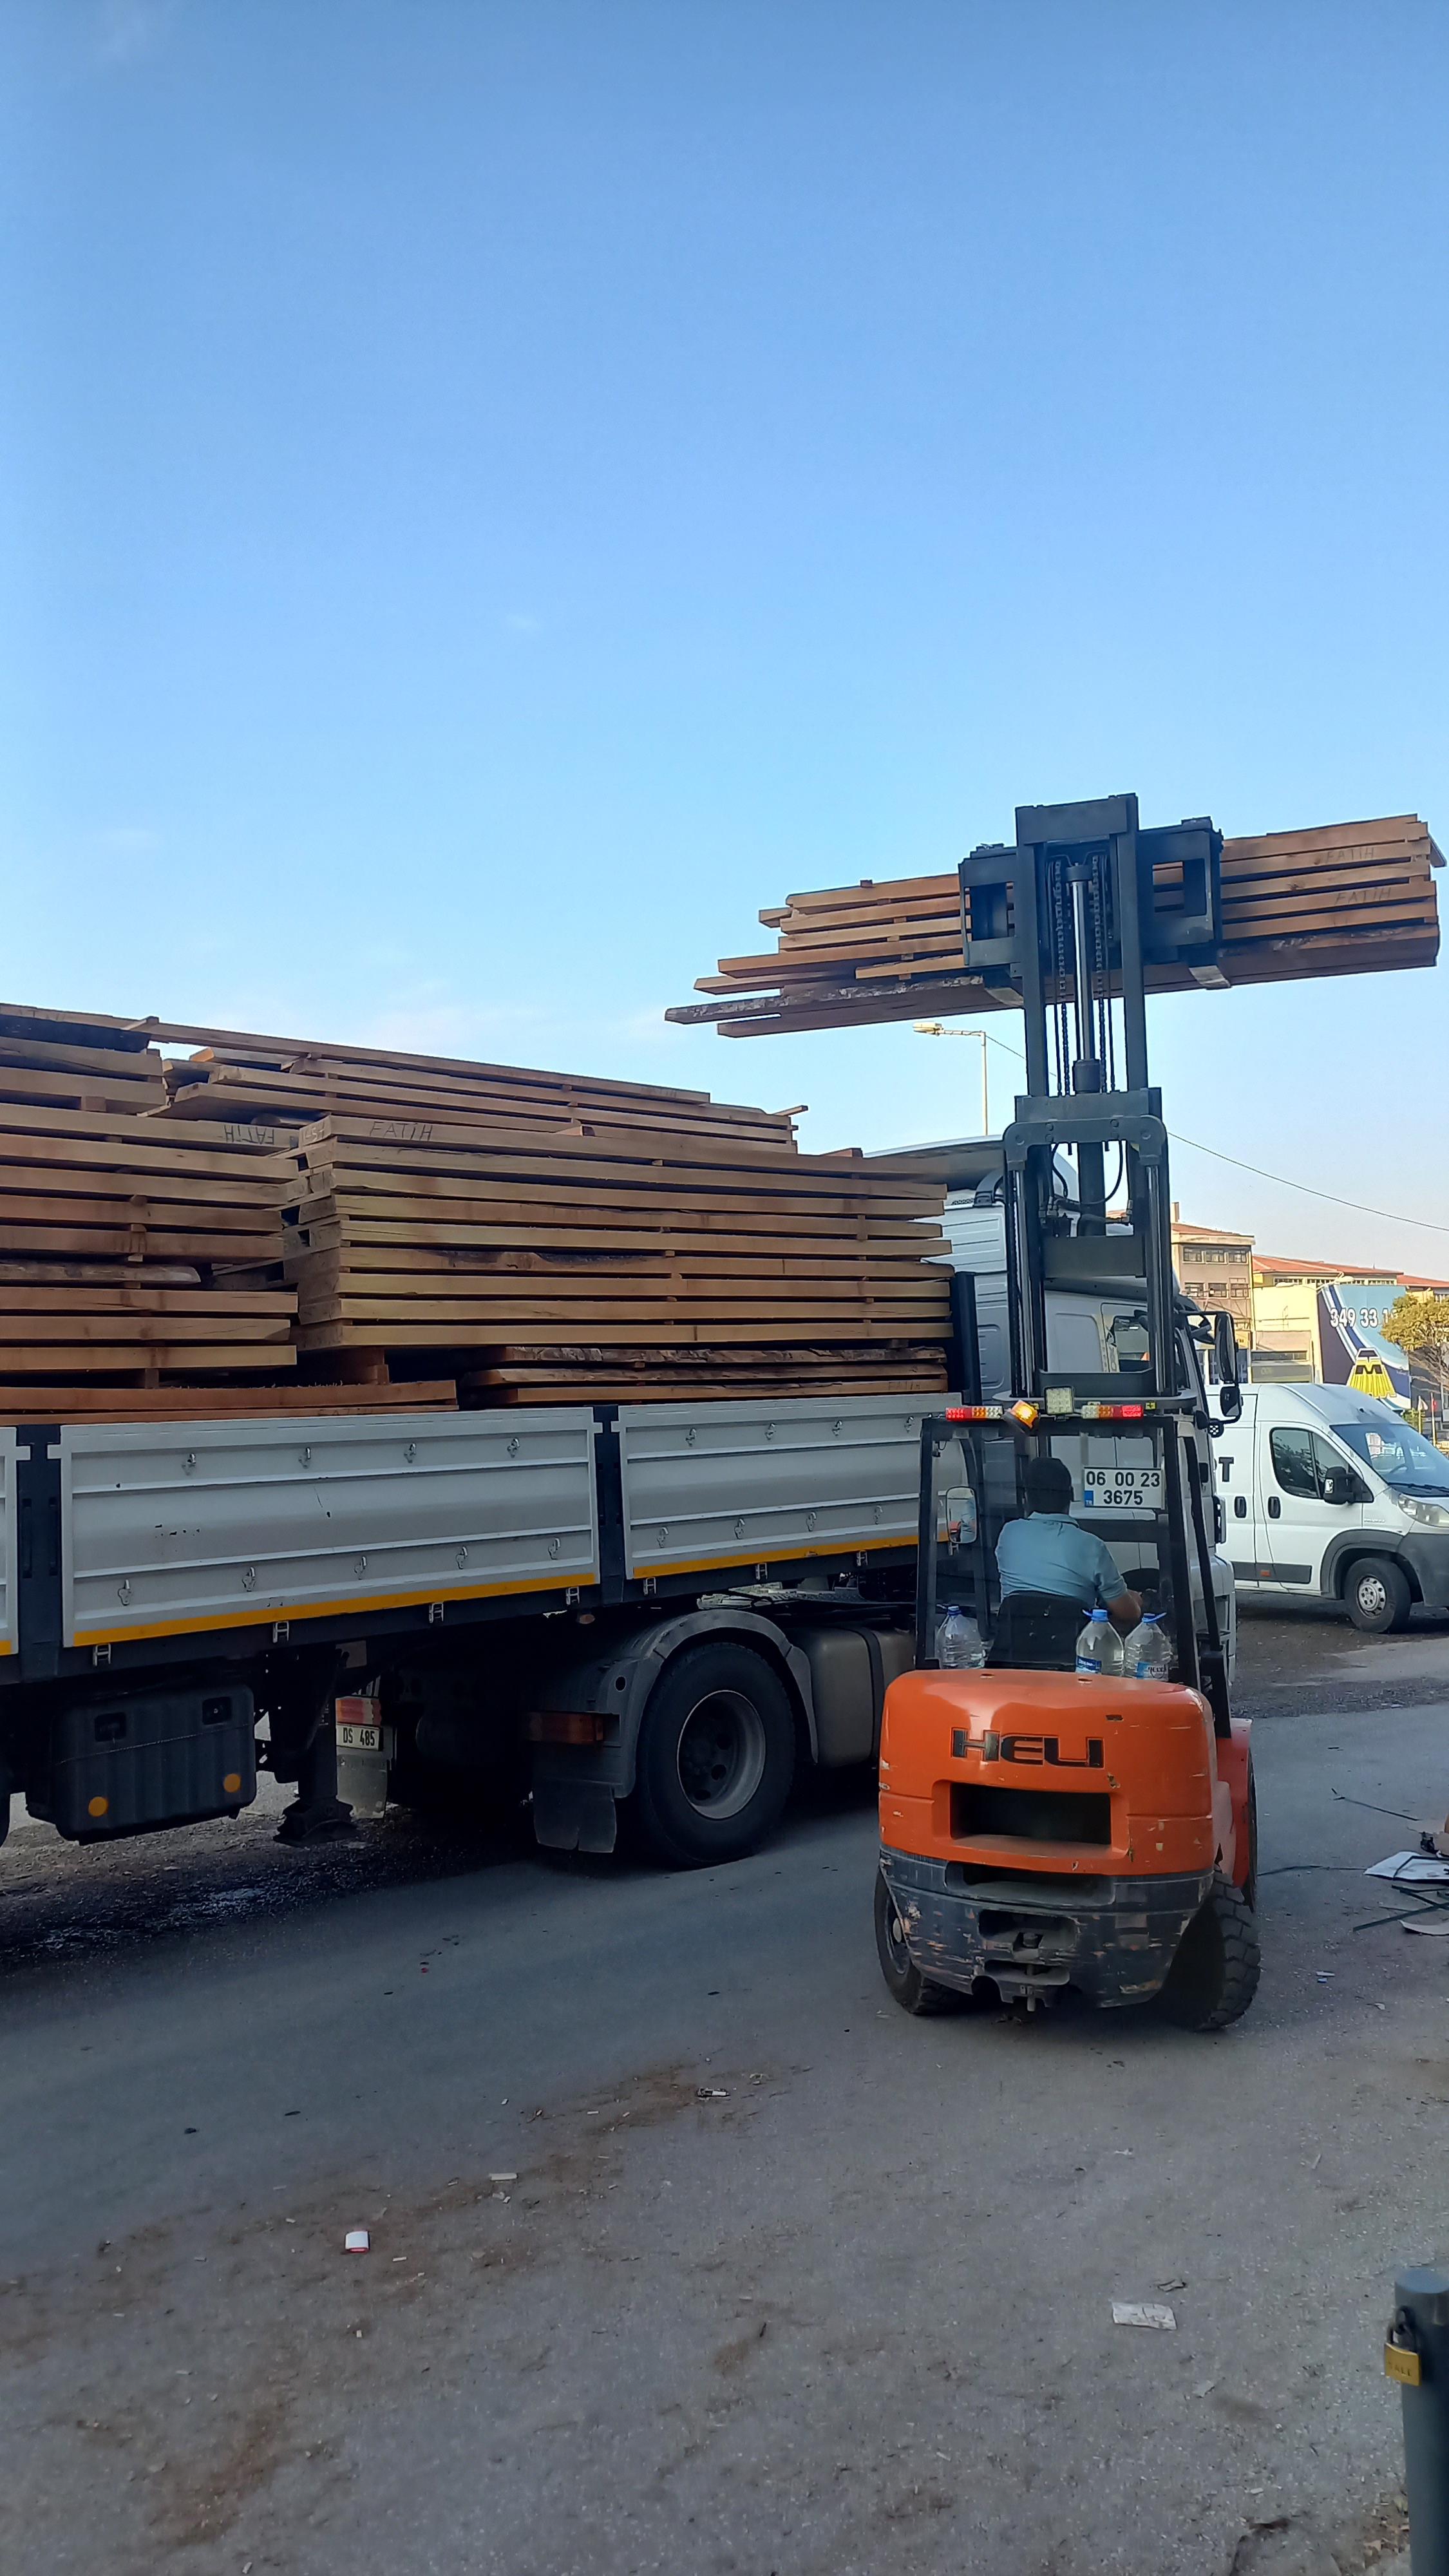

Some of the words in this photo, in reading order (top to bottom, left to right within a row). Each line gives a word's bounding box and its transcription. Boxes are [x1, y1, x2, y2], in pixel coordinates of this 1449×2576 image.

[1330, 1307, 1356, 1328] 349
[1359, 1308, 1378, 1328] 33
[1086, 1471, 1106, 1486] 06
[1115, 1472, 1134, 1486] 00
[1141, 1472, 1160, 1487] 23
[1103, 1490, 1143, 1505] 3675
[343, 1727, 353, 1743] DS
[359, 1729, 375, 1746] 485
[952, 1728, 1104, 1769] HELI
